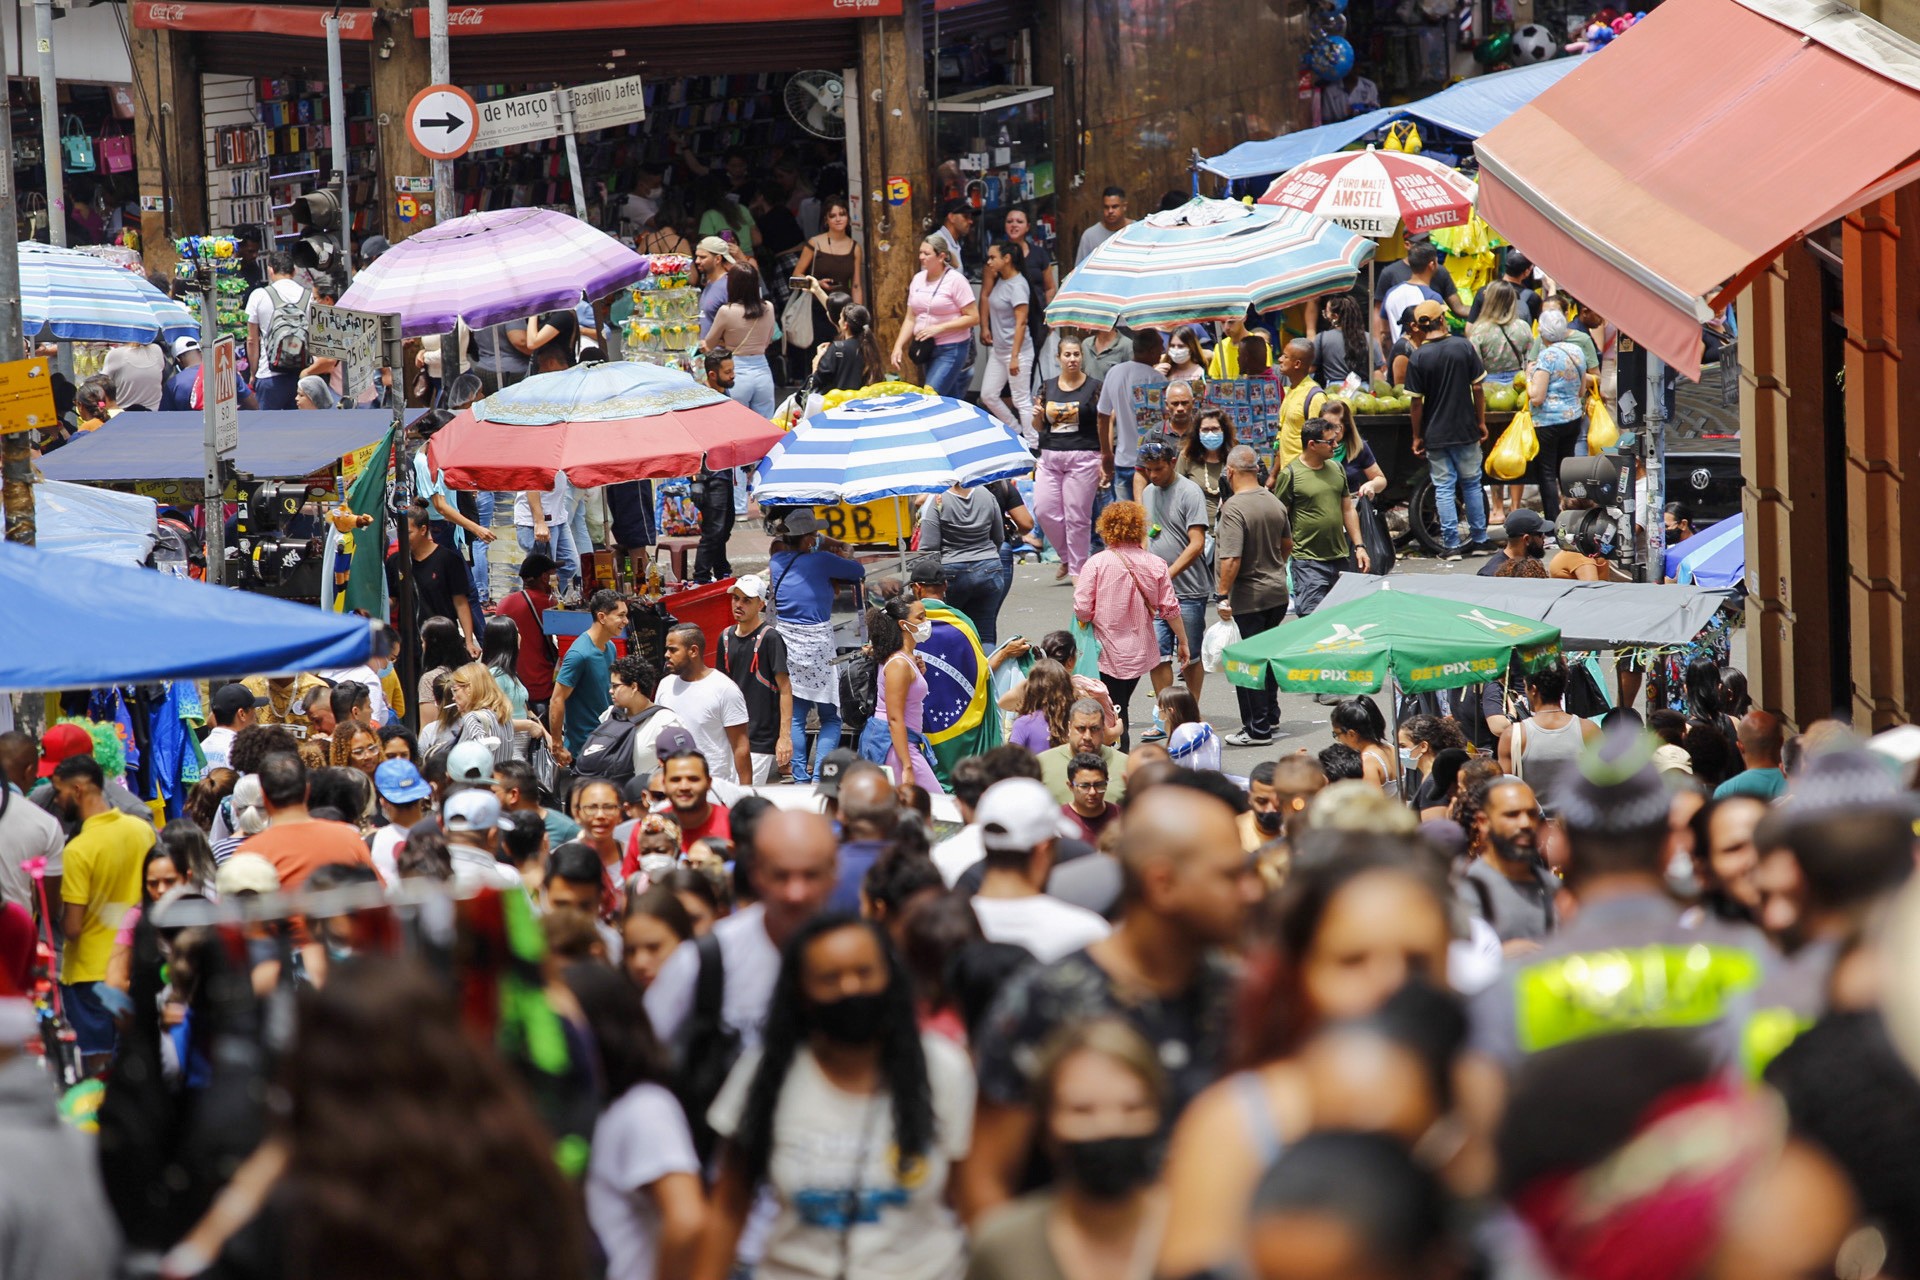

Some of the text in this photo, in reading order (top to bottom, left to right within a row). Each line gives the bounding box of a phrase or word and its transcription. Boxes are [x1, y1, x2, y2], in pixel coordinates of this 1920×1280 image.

[574, 81, 641, 107] Basílio Jafet
[484, 98, 548, 123] de Março
[887, 182, 910, 200] 13
[1338, 177, 1386, 190] PURO MALTE
[1416, 184, 1448, 199] PAULO
[398, 199, 417, 217] 13
[1332, 190, 1383, 209] AMSTEL
[1416, 210, 1460, 229] AMSTEL
[346, 347, 357, 369] 25
[926, 655, 974, 693] PROGRESSO
[1287, 668, 1374, 683] BETPIX365
[1410, 657, 1498, 681] BETPIX365
